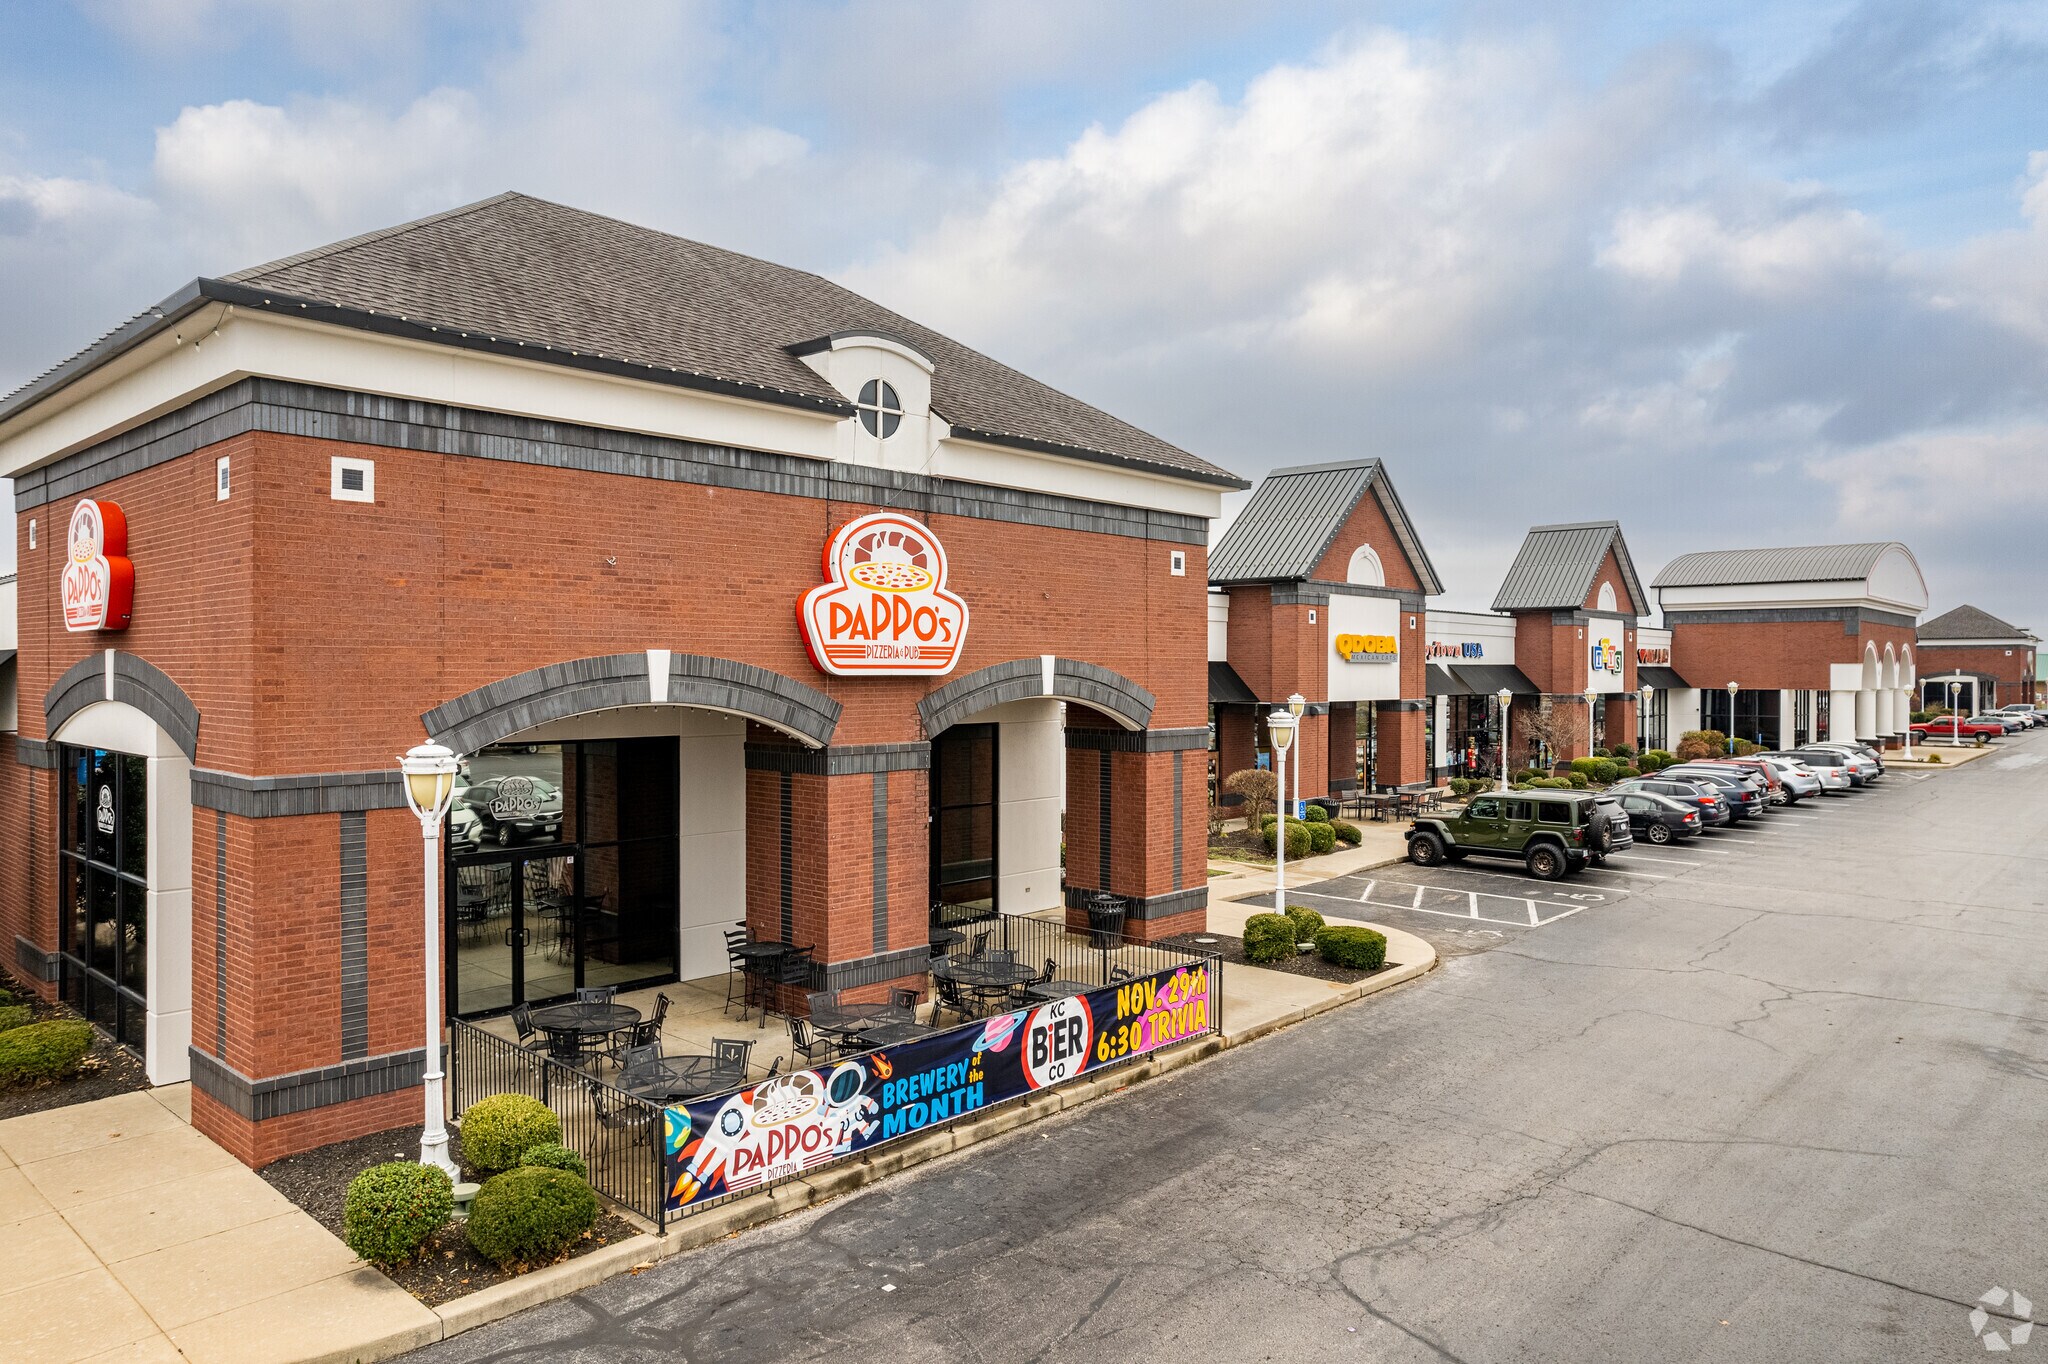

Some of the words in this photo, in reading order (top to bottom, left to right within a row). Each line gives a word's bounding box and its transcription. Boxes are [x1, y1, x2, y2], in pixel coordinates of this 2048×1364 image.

[867, 644, 900, 659] PIZZERIA
[904, 645, 919, 659] PUB
[1336, 633, 1397, 661] QDOBA
[1464, 643, 1484, 658] USA
[1593, 638, 1622, 674] TOYS
[1117, 977, 1162, 1020] NOV.
[1050, 1001, 1066, 1020] KC
[1097, 1021, 1142, 1062] 6:30
[1148, 999, 1207, 1045] TRIVIA
[883, 1058, 969, 1109] BREWERY
[971, 1051, 983, 1066] of
[969, 1068, 984, 1083] the
[1048, 1062, 1065, 1081] CO
[883, 1081, 984, 1138] MONTH
[767, 1162, 798, 1180] PIZZERIA
